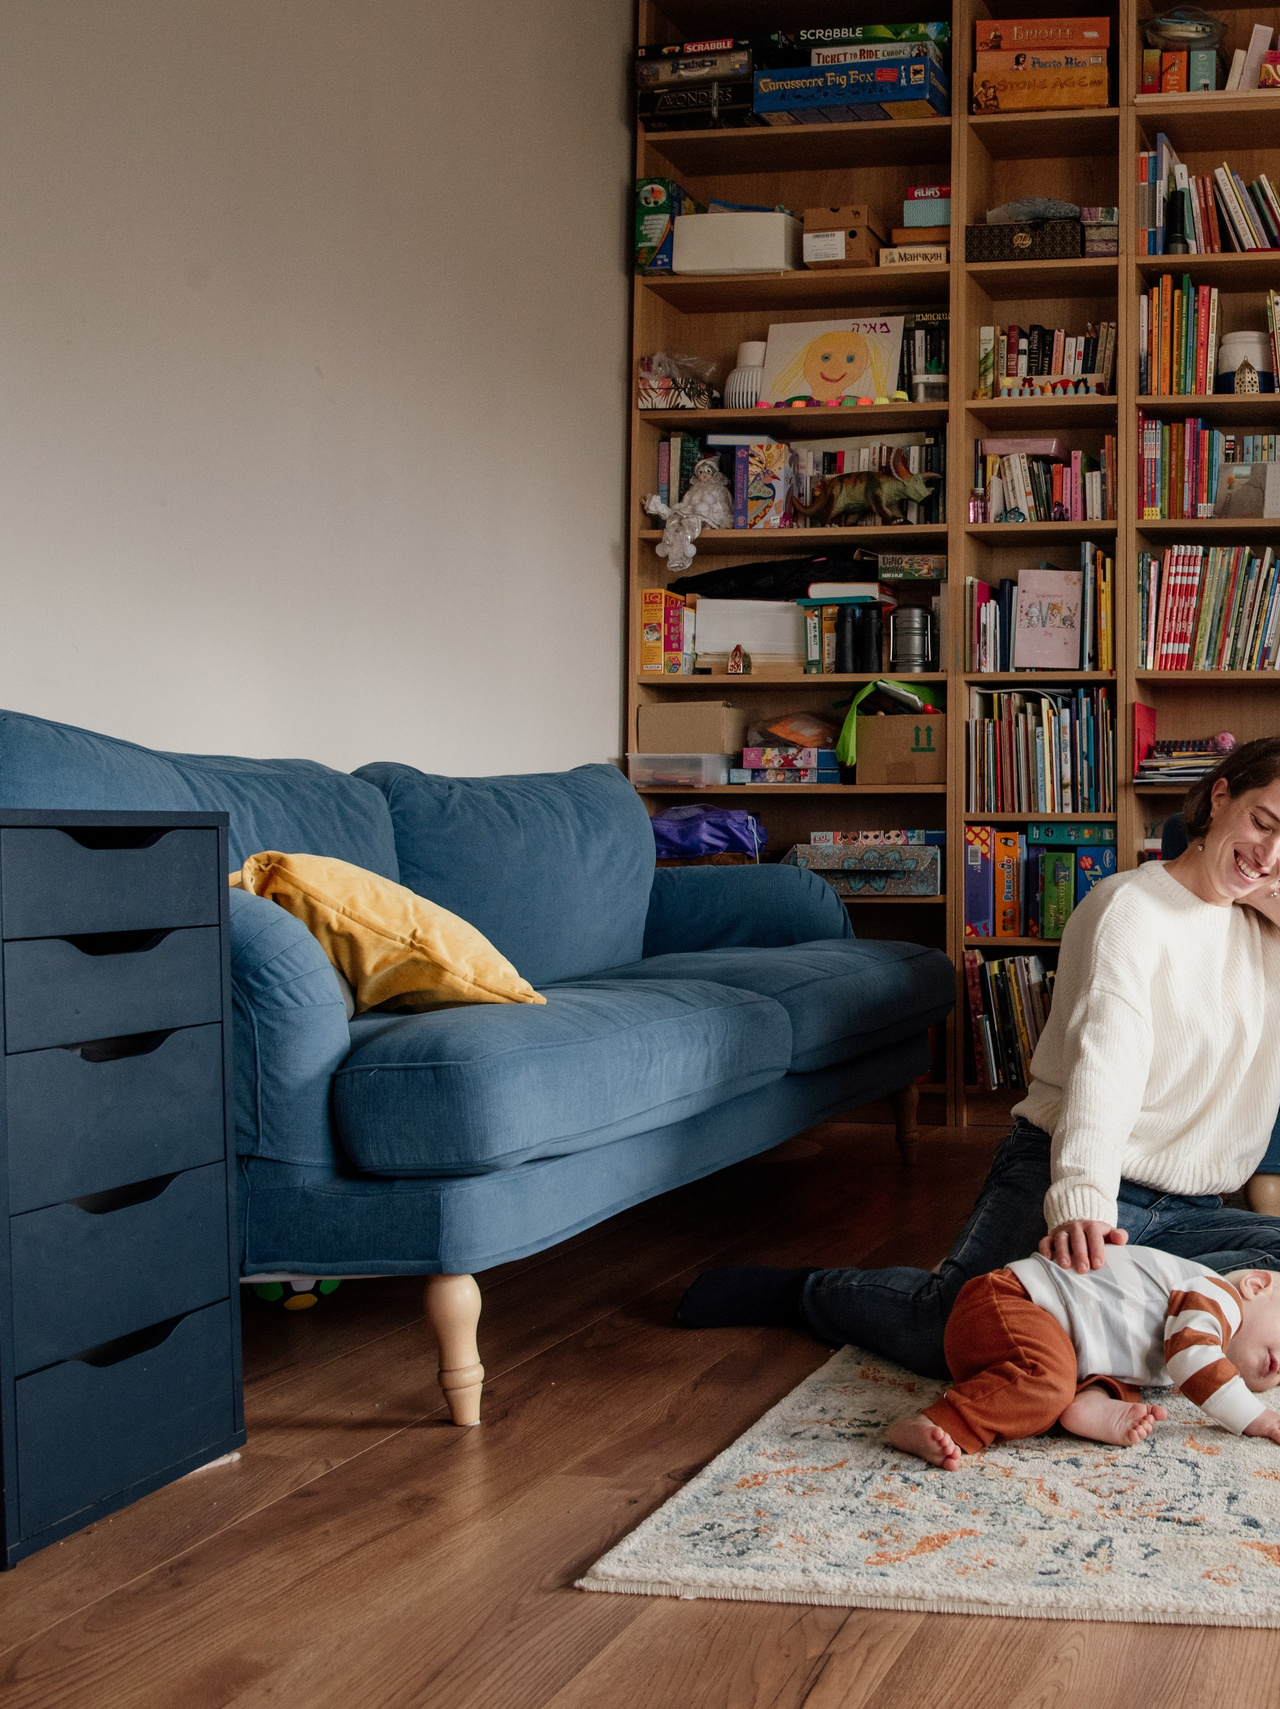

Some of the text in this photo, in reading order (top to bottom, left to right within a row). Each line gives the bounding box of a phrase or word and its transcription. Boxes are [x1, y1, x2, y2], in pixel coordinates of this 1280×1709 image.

[799, 27, 863, 41] SCRABBLE
[686, 40, 733, 53] SCRABBLE
[815, 51, 848, 65] TICKET
[859, 48, 880, 60] RIDE
[1031, 56, 1087, 69] Puerto Rico
[826, 71, 847, 88] Big
[848, 69, 874, 85] Box
[996, 78, 1048, 91] STONE
[1052, 76, 1088, 90] AGE
[851, 321, 891, 335] מאיה
[645, 593, 661, 604] IQ
